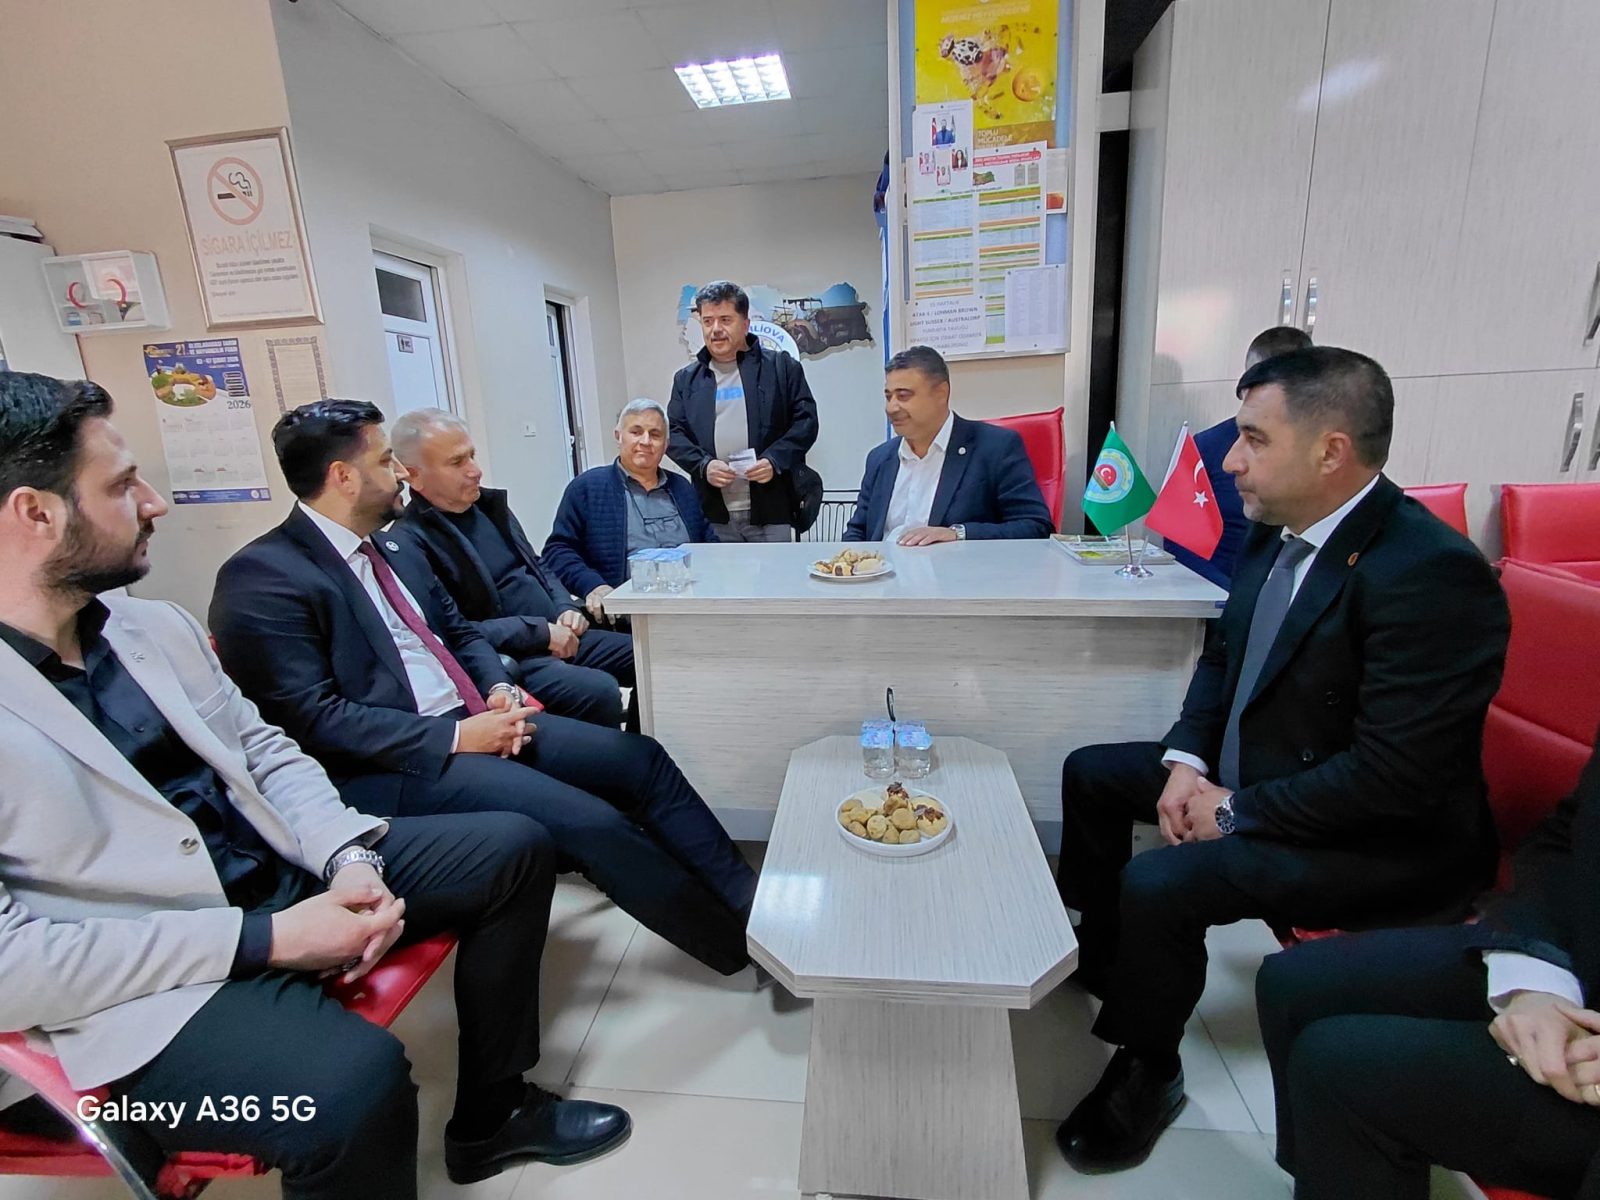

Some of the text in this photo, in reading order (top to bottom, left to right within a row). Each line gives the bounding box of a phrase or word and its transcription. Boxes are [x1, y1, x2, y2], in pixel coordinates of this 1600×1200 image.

[201, 229, 294, 256] SİGARA İÇİLMEZ
[227, 400, 251, 410] 2026
